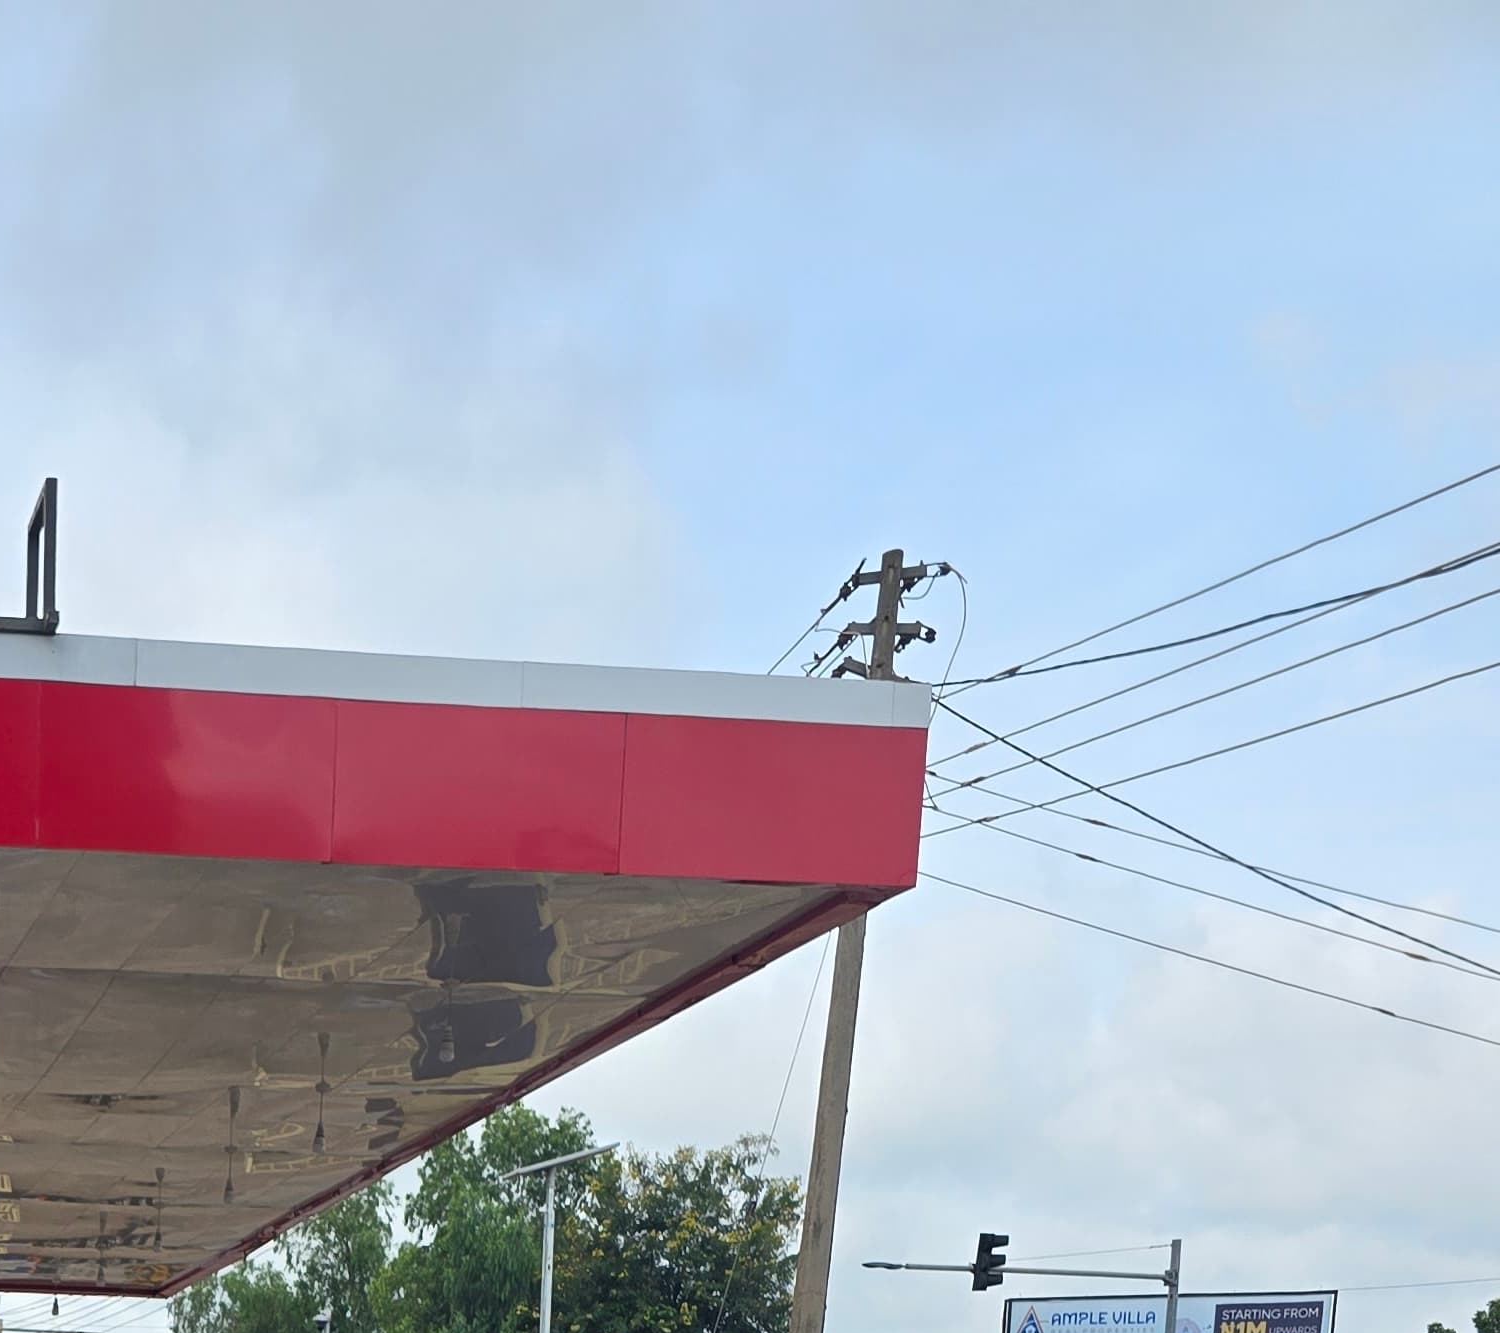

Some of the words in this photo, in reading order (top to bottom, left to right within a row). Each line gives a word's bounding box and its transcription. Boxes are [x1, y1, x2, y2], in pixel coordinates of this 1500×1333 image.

[1051, 1312, 1108, 1326] AMPLE
[1113, 1311, 1156, 1325] VILLA
[1222, 1308, 1281, 1320] STARTING
[1283, 1307, 1319, 1318] FROM
